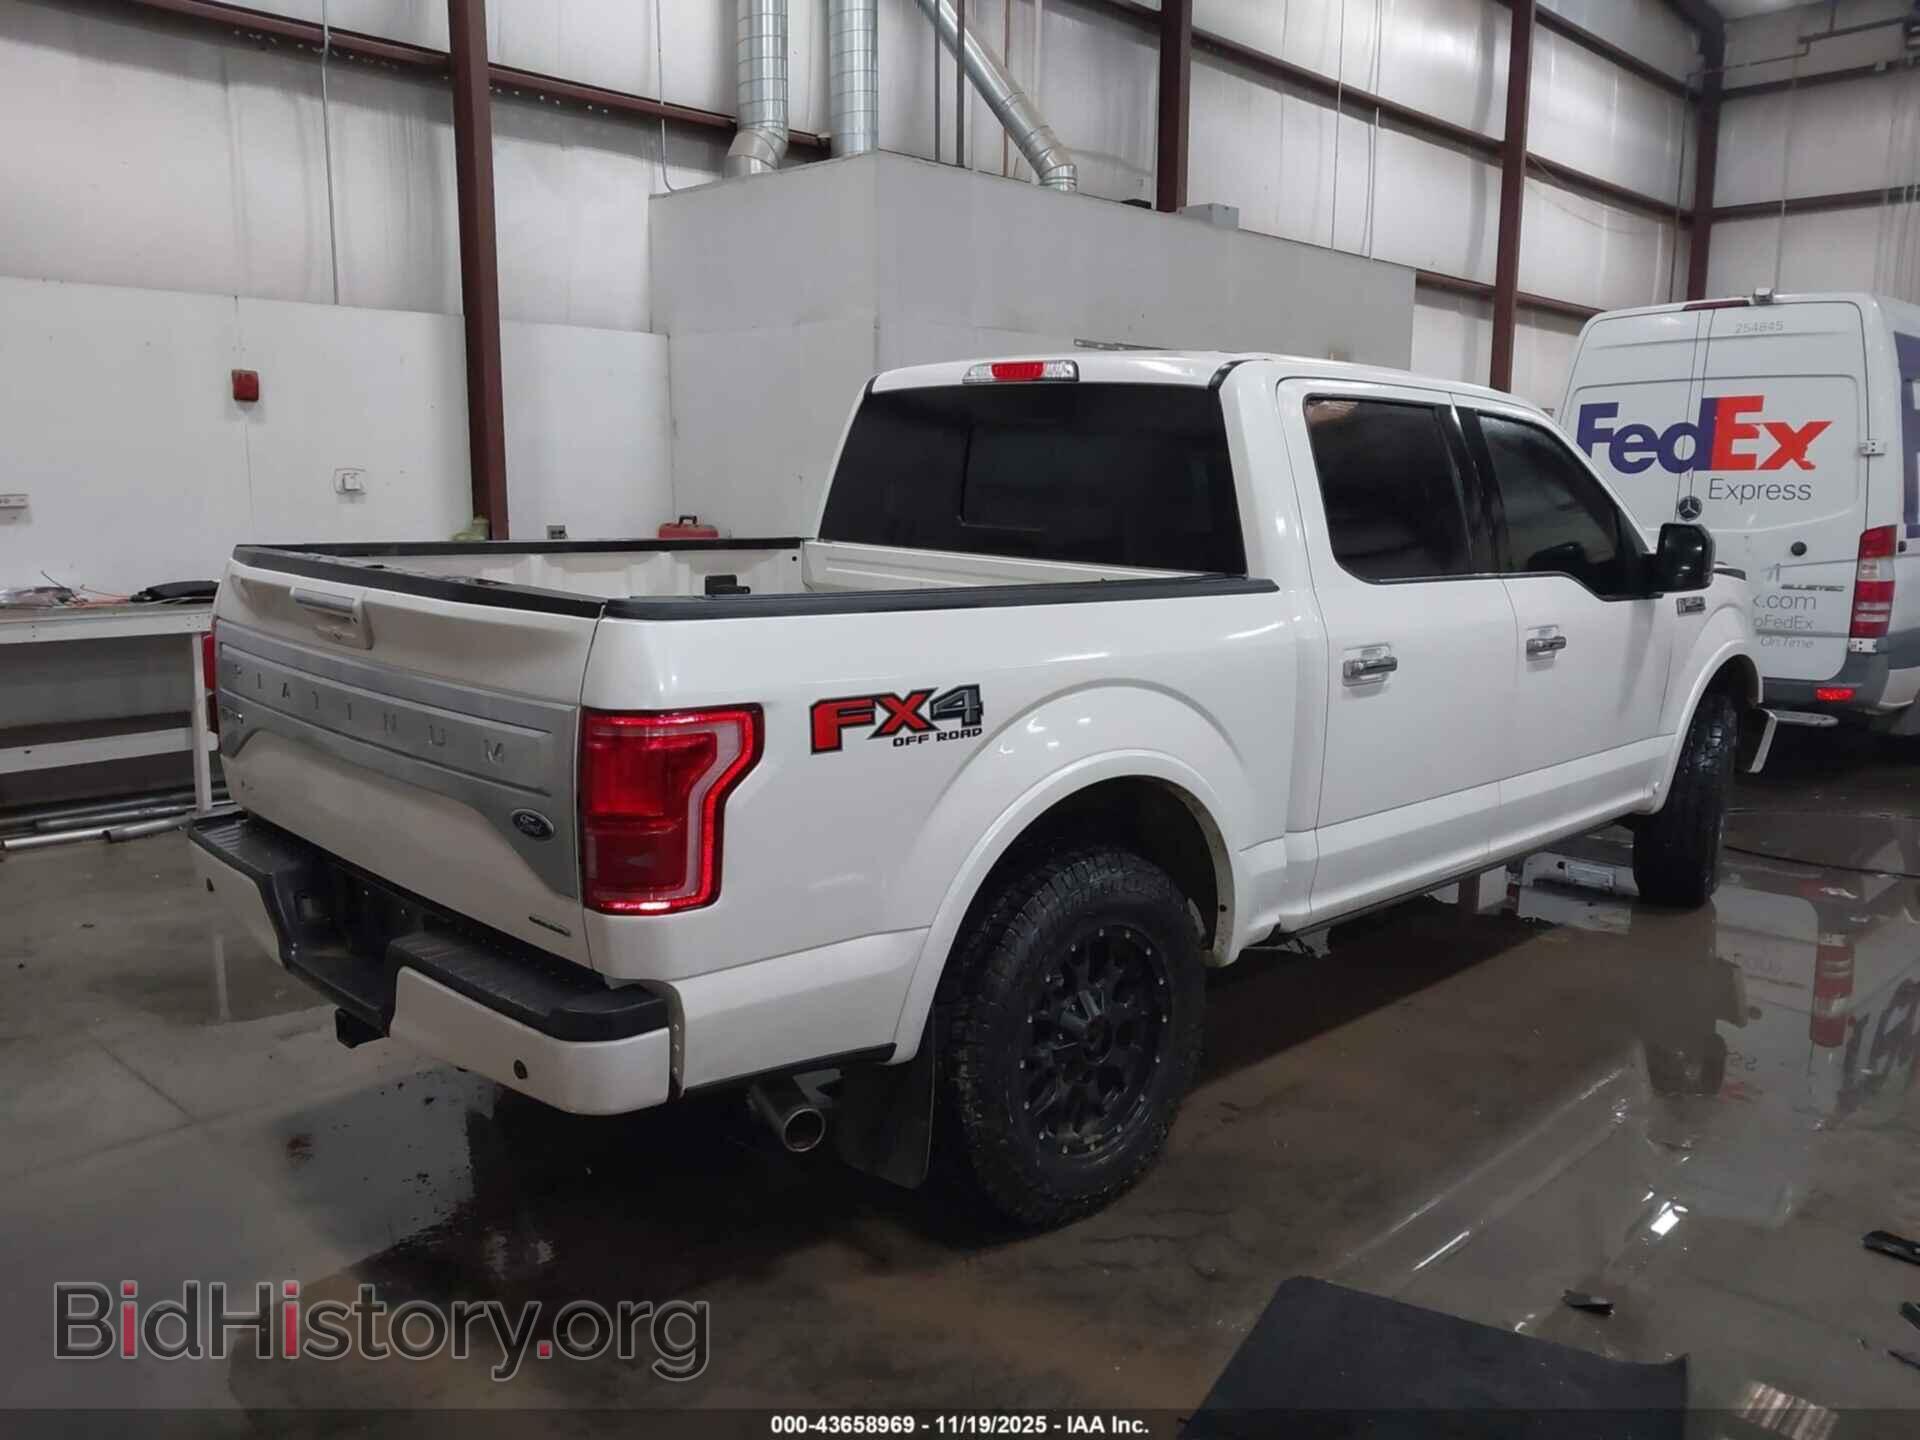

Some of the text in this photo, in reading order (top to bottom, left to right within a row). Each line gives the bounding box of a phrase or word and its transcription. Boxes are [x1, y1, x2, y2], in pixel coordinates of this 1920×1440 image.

[1577, 395, 1833, 475] FedEx
[1708, 477, 1813, 505] Express
[810, 683, 984, 756] FX4
[892, 727, 983, 748] OFF ROAD
